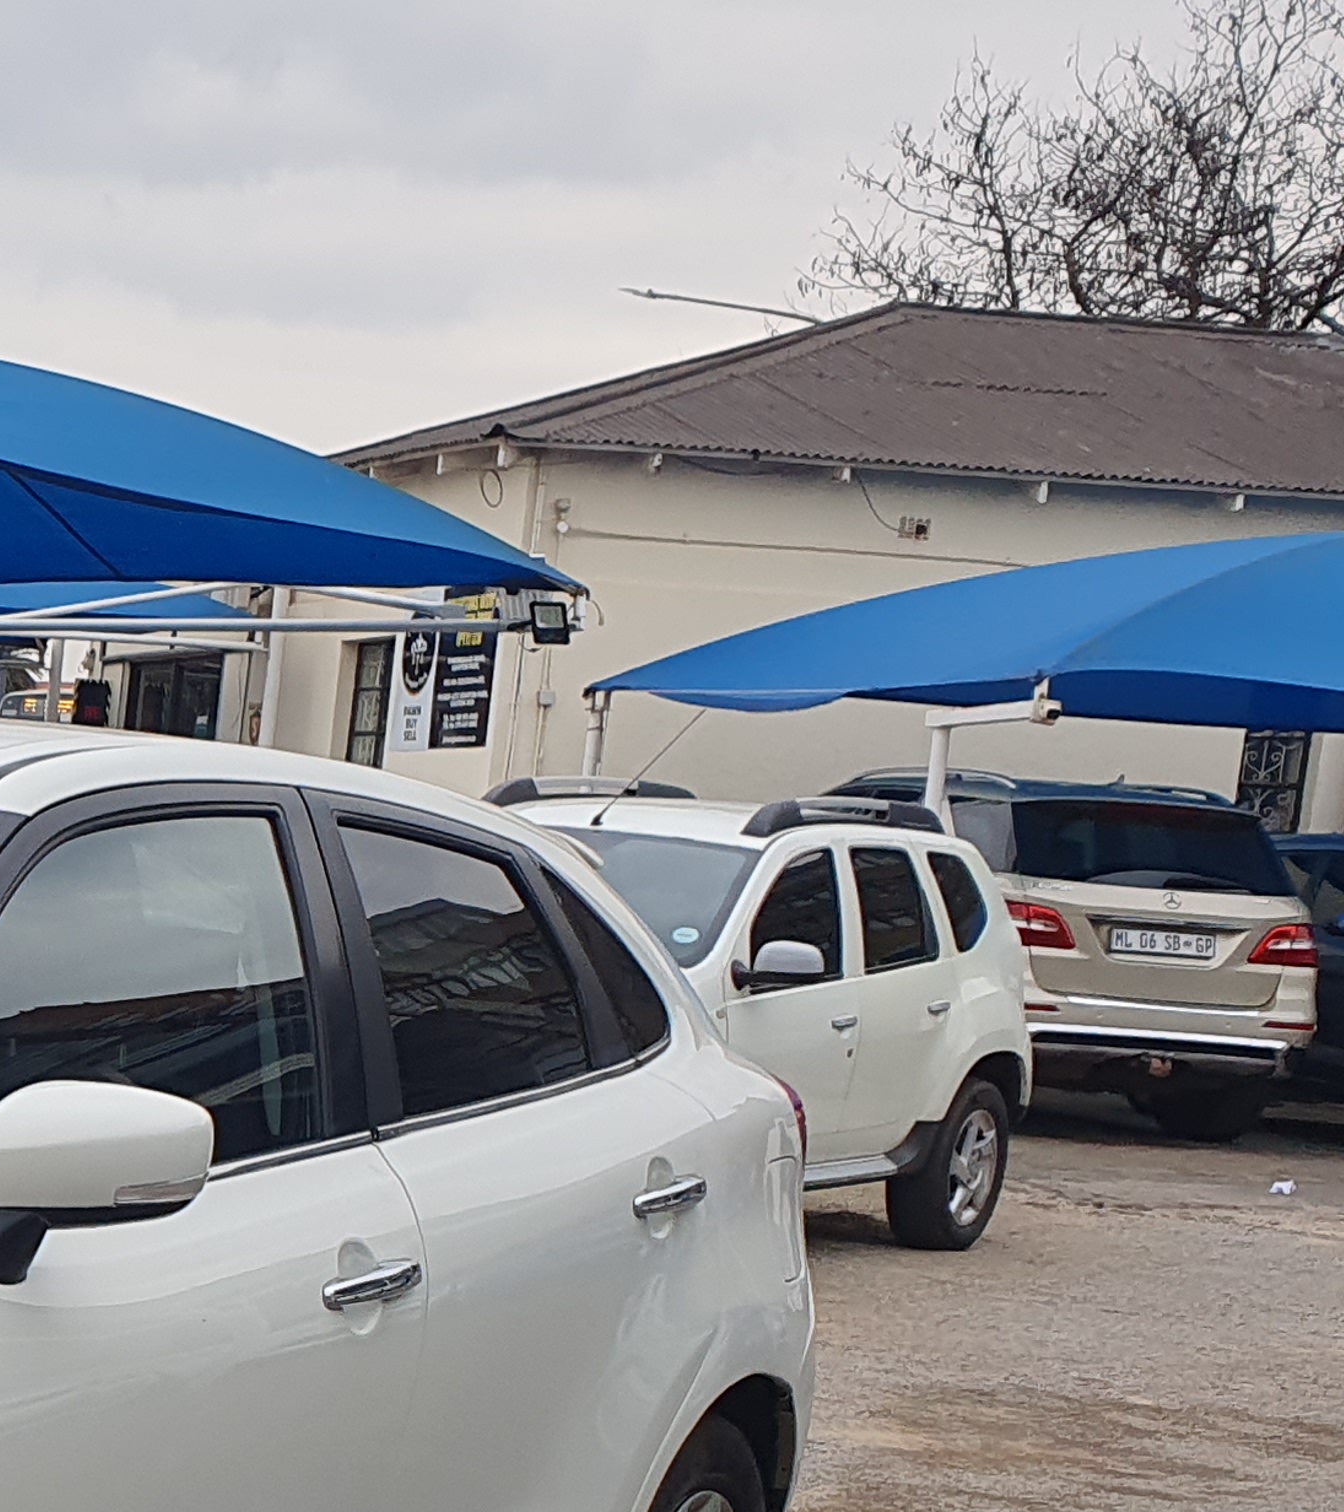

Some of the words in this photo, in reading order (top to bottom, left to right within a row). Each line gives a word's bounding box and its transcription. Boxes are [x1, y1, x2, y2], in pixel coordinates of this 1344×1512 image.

[1115, 931, 1133, 948] ML
[1140, 932, 1157, 949] 06
[1164, 935, 1181, 951] SB
[1196, 937, 1212, 953] GP
